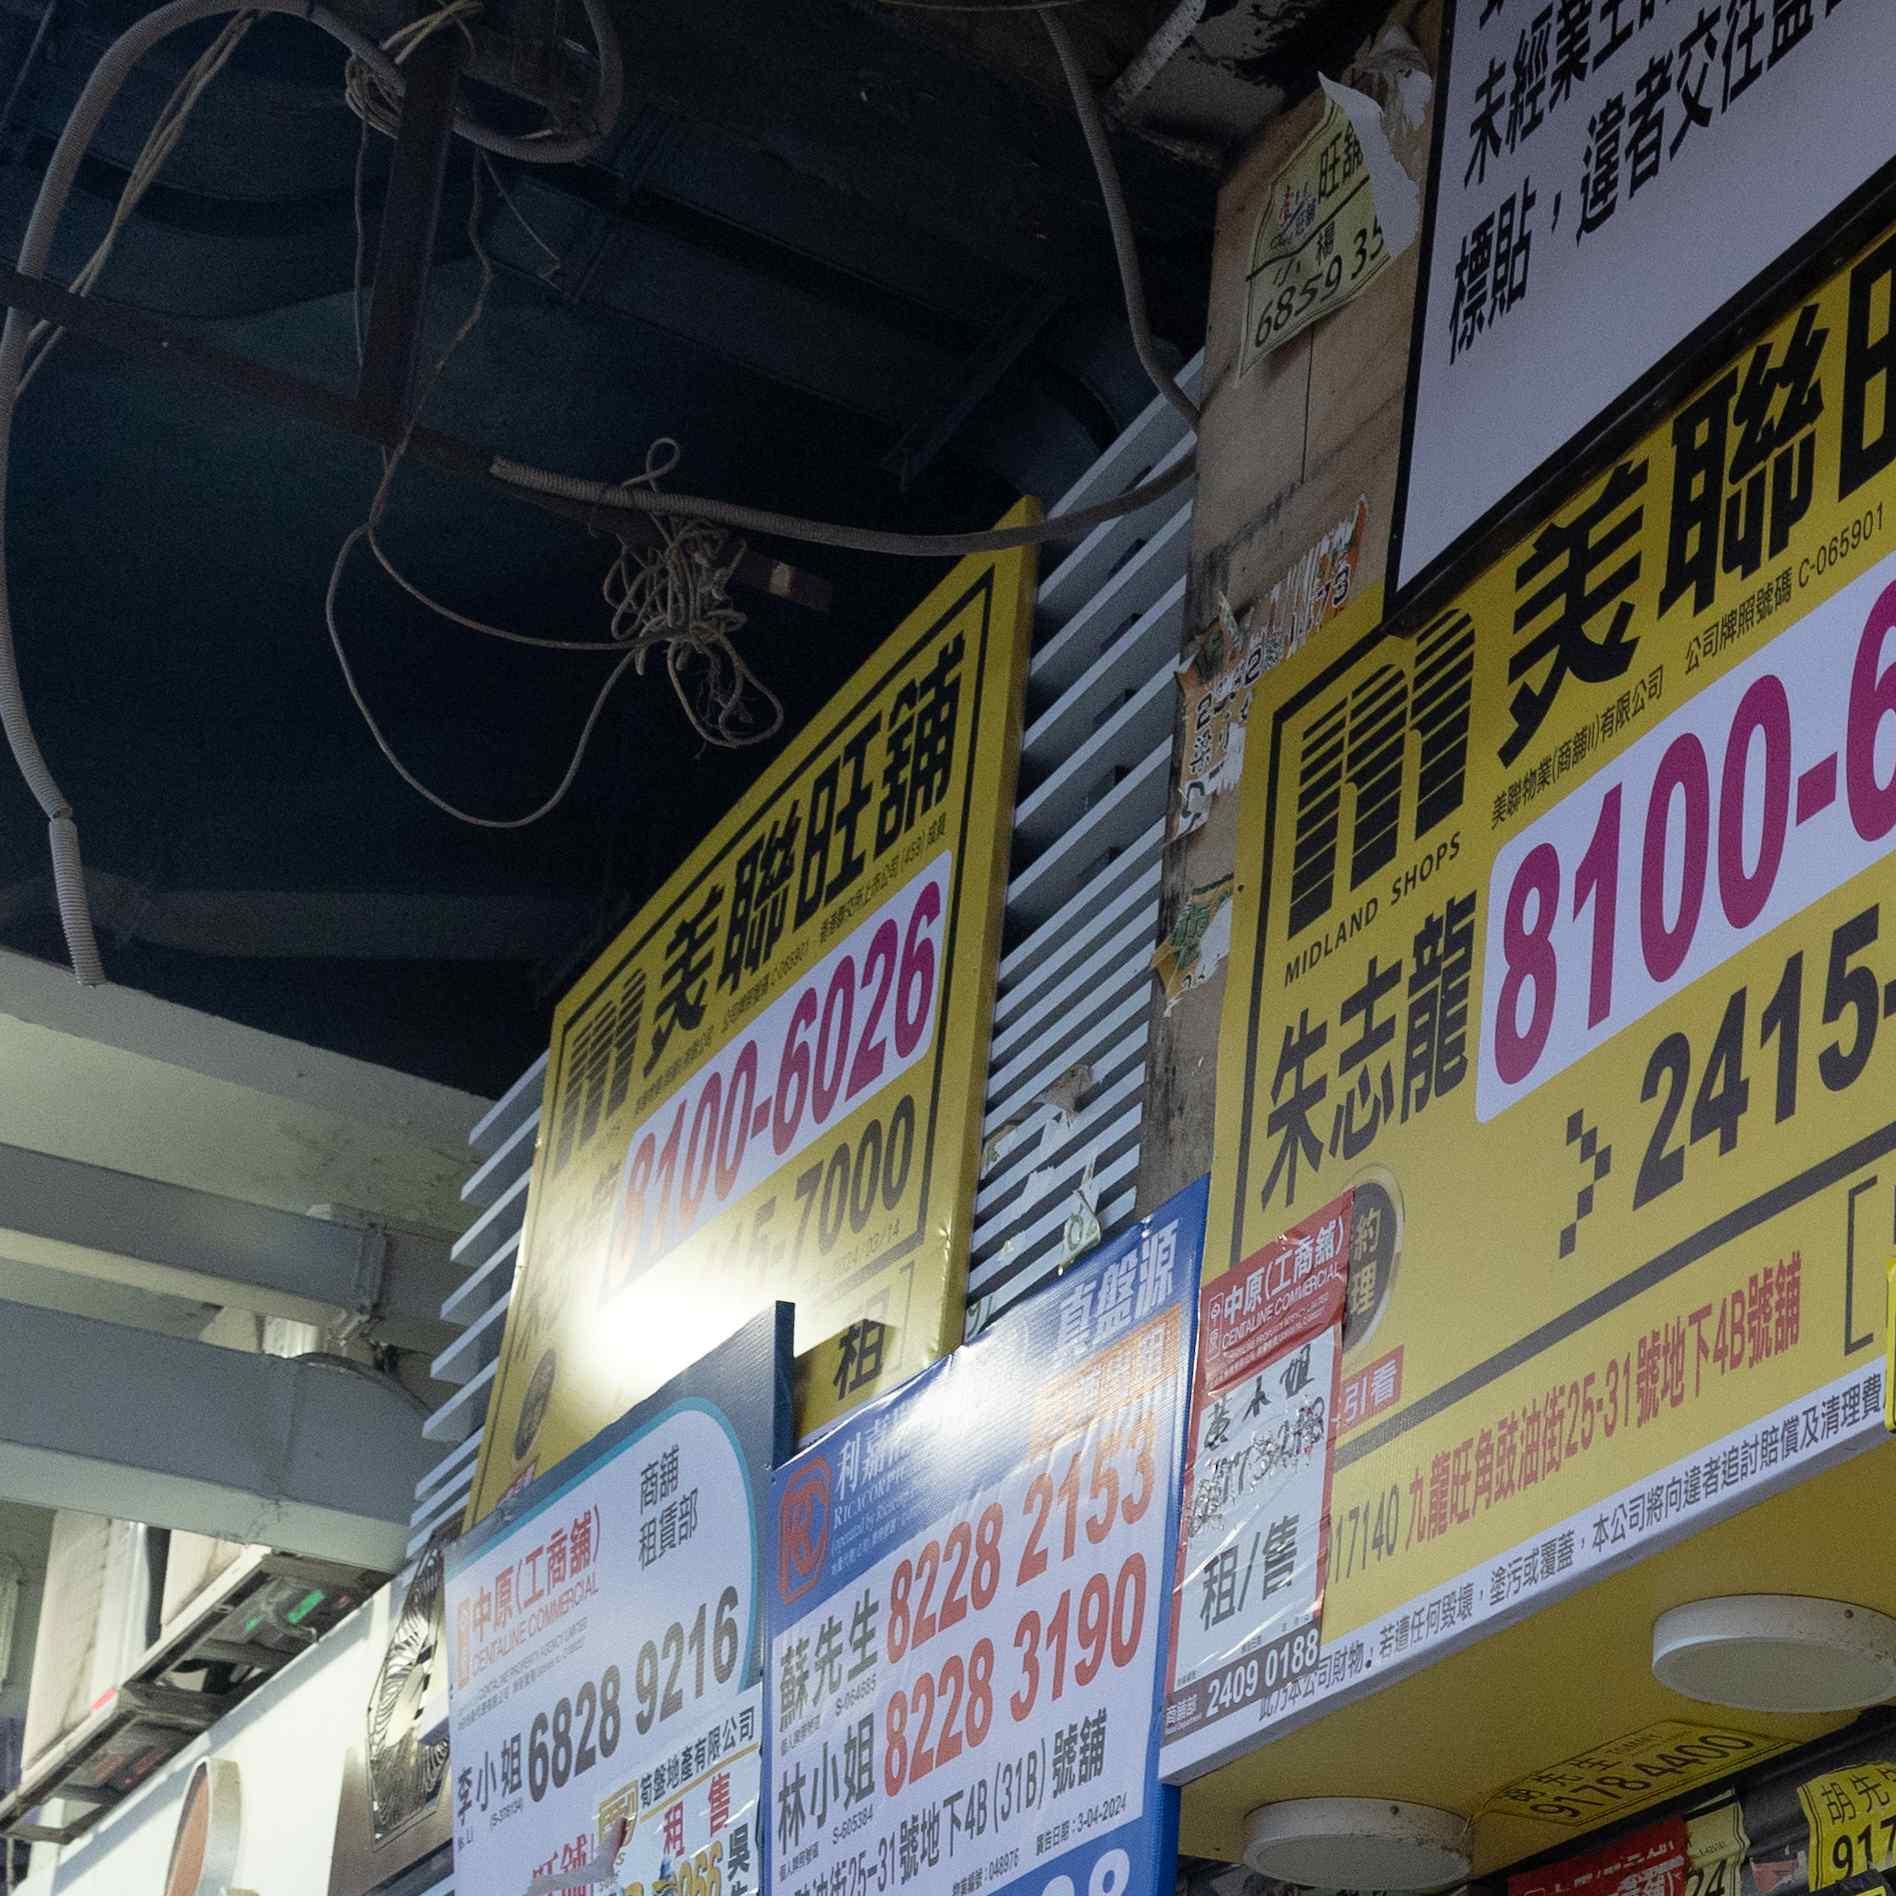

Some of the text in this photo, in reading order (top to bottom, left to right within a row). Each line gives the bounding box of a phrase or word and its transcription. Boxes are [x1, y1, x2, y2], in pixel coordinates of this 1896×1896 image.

[1255, 259, 1343, 347] 6859
[643, 627, 968, 1087] 美聯旺舖
[1284, 835, 1463, 988] MIDLAND SHOPS
[606, 880, 942, 1290] 8100-6026
[1259, 887, 1477, 1213] 朱志龍
[1059, 1219, 1180, 1359] 真盤源
[639, 1444, 679, 1515] 商舖
[885, 1503, 1003, 1664] 8228
[1016, 1413, 1156, 1587] 2153
[1200, 1514, 1300, 1633] 租/售
[457, 1732, 523, 1826] 李小姐
[528, 1664, 620, 1802] 6828
[635, 1585, 739, 1736] 9216
[778, 1551, 1146, 1855] 林小姐 8228 3190
[1207, 1658, 1259, 1716] 2409
[1264, 1632, 1320, 1689] 0188
[1530, 1734, 1754, 1818] 9178 4400
